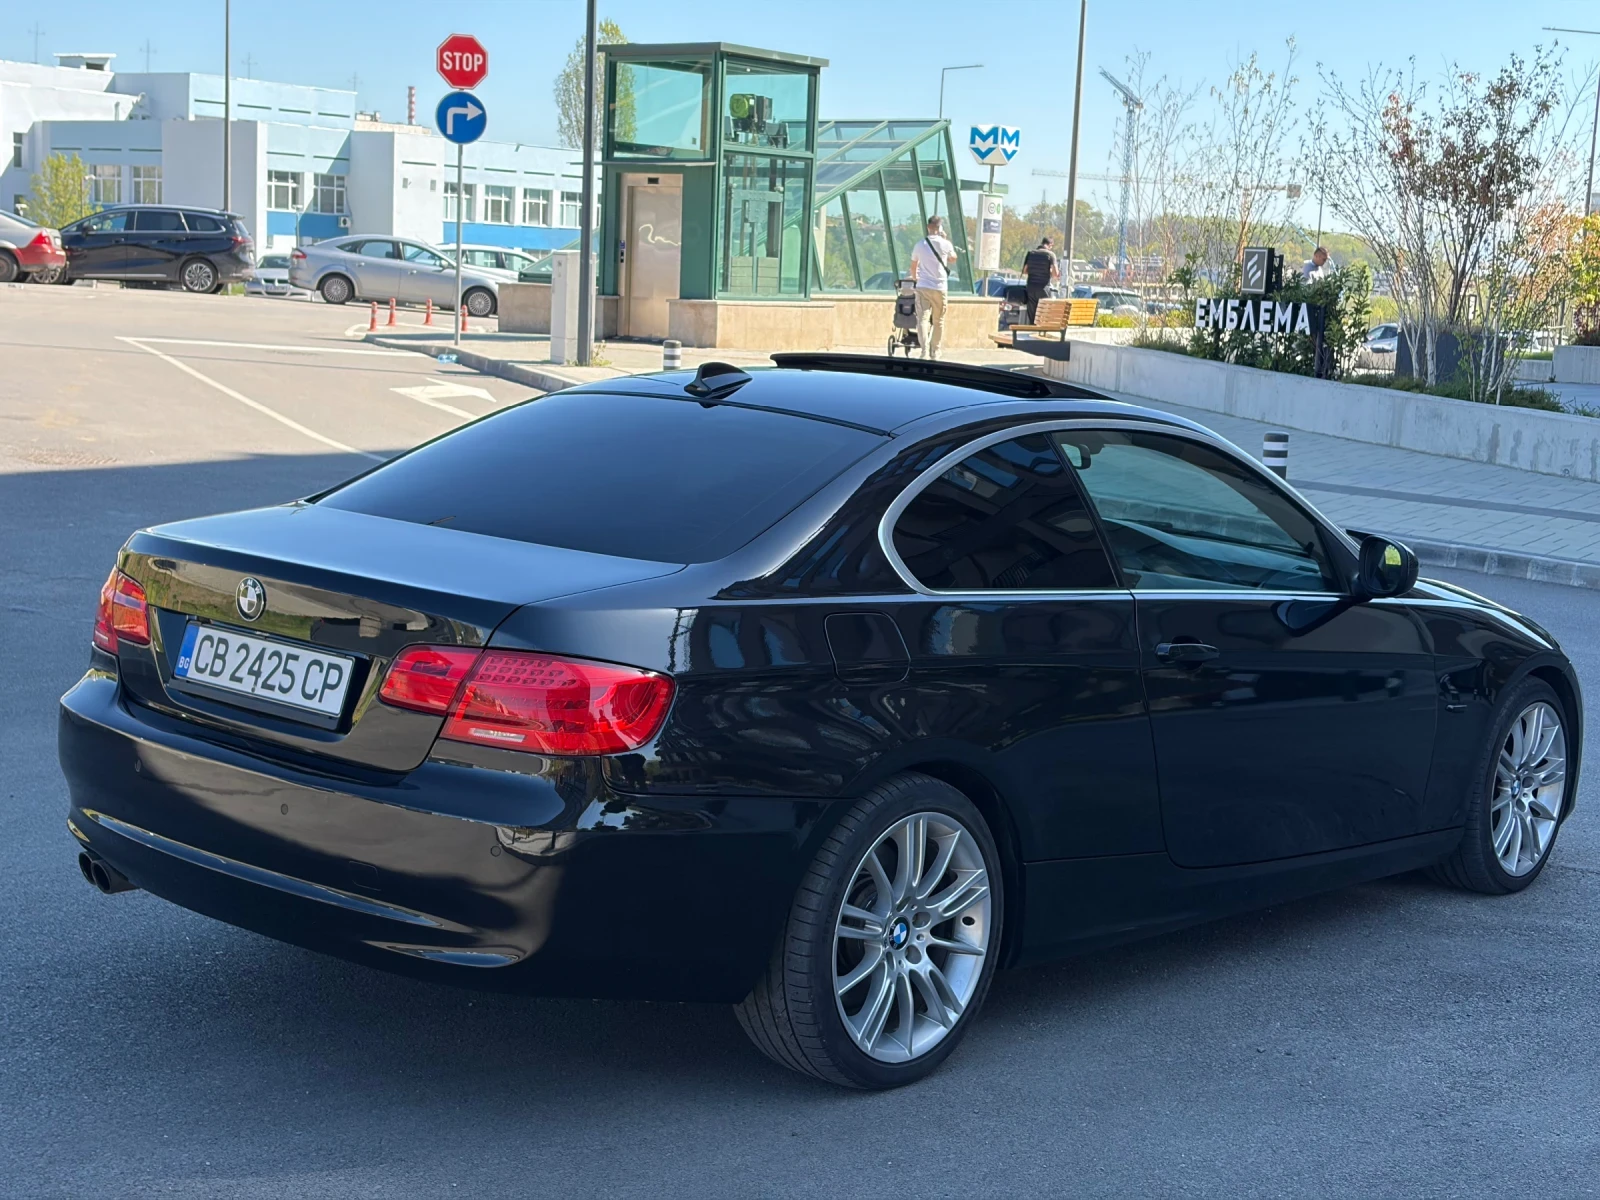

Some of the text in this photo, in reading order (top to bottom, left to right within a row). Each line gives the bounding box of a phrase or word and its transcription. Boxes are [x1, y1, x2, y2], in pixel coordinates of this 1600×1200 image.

[443, 51, 483, 72] STOP
[1195, 298, 1311, 335] ЕМБЛЕМА
[179, 657, 190, 669] BG
[194, 634, 343, 703] CB 2425 CP
